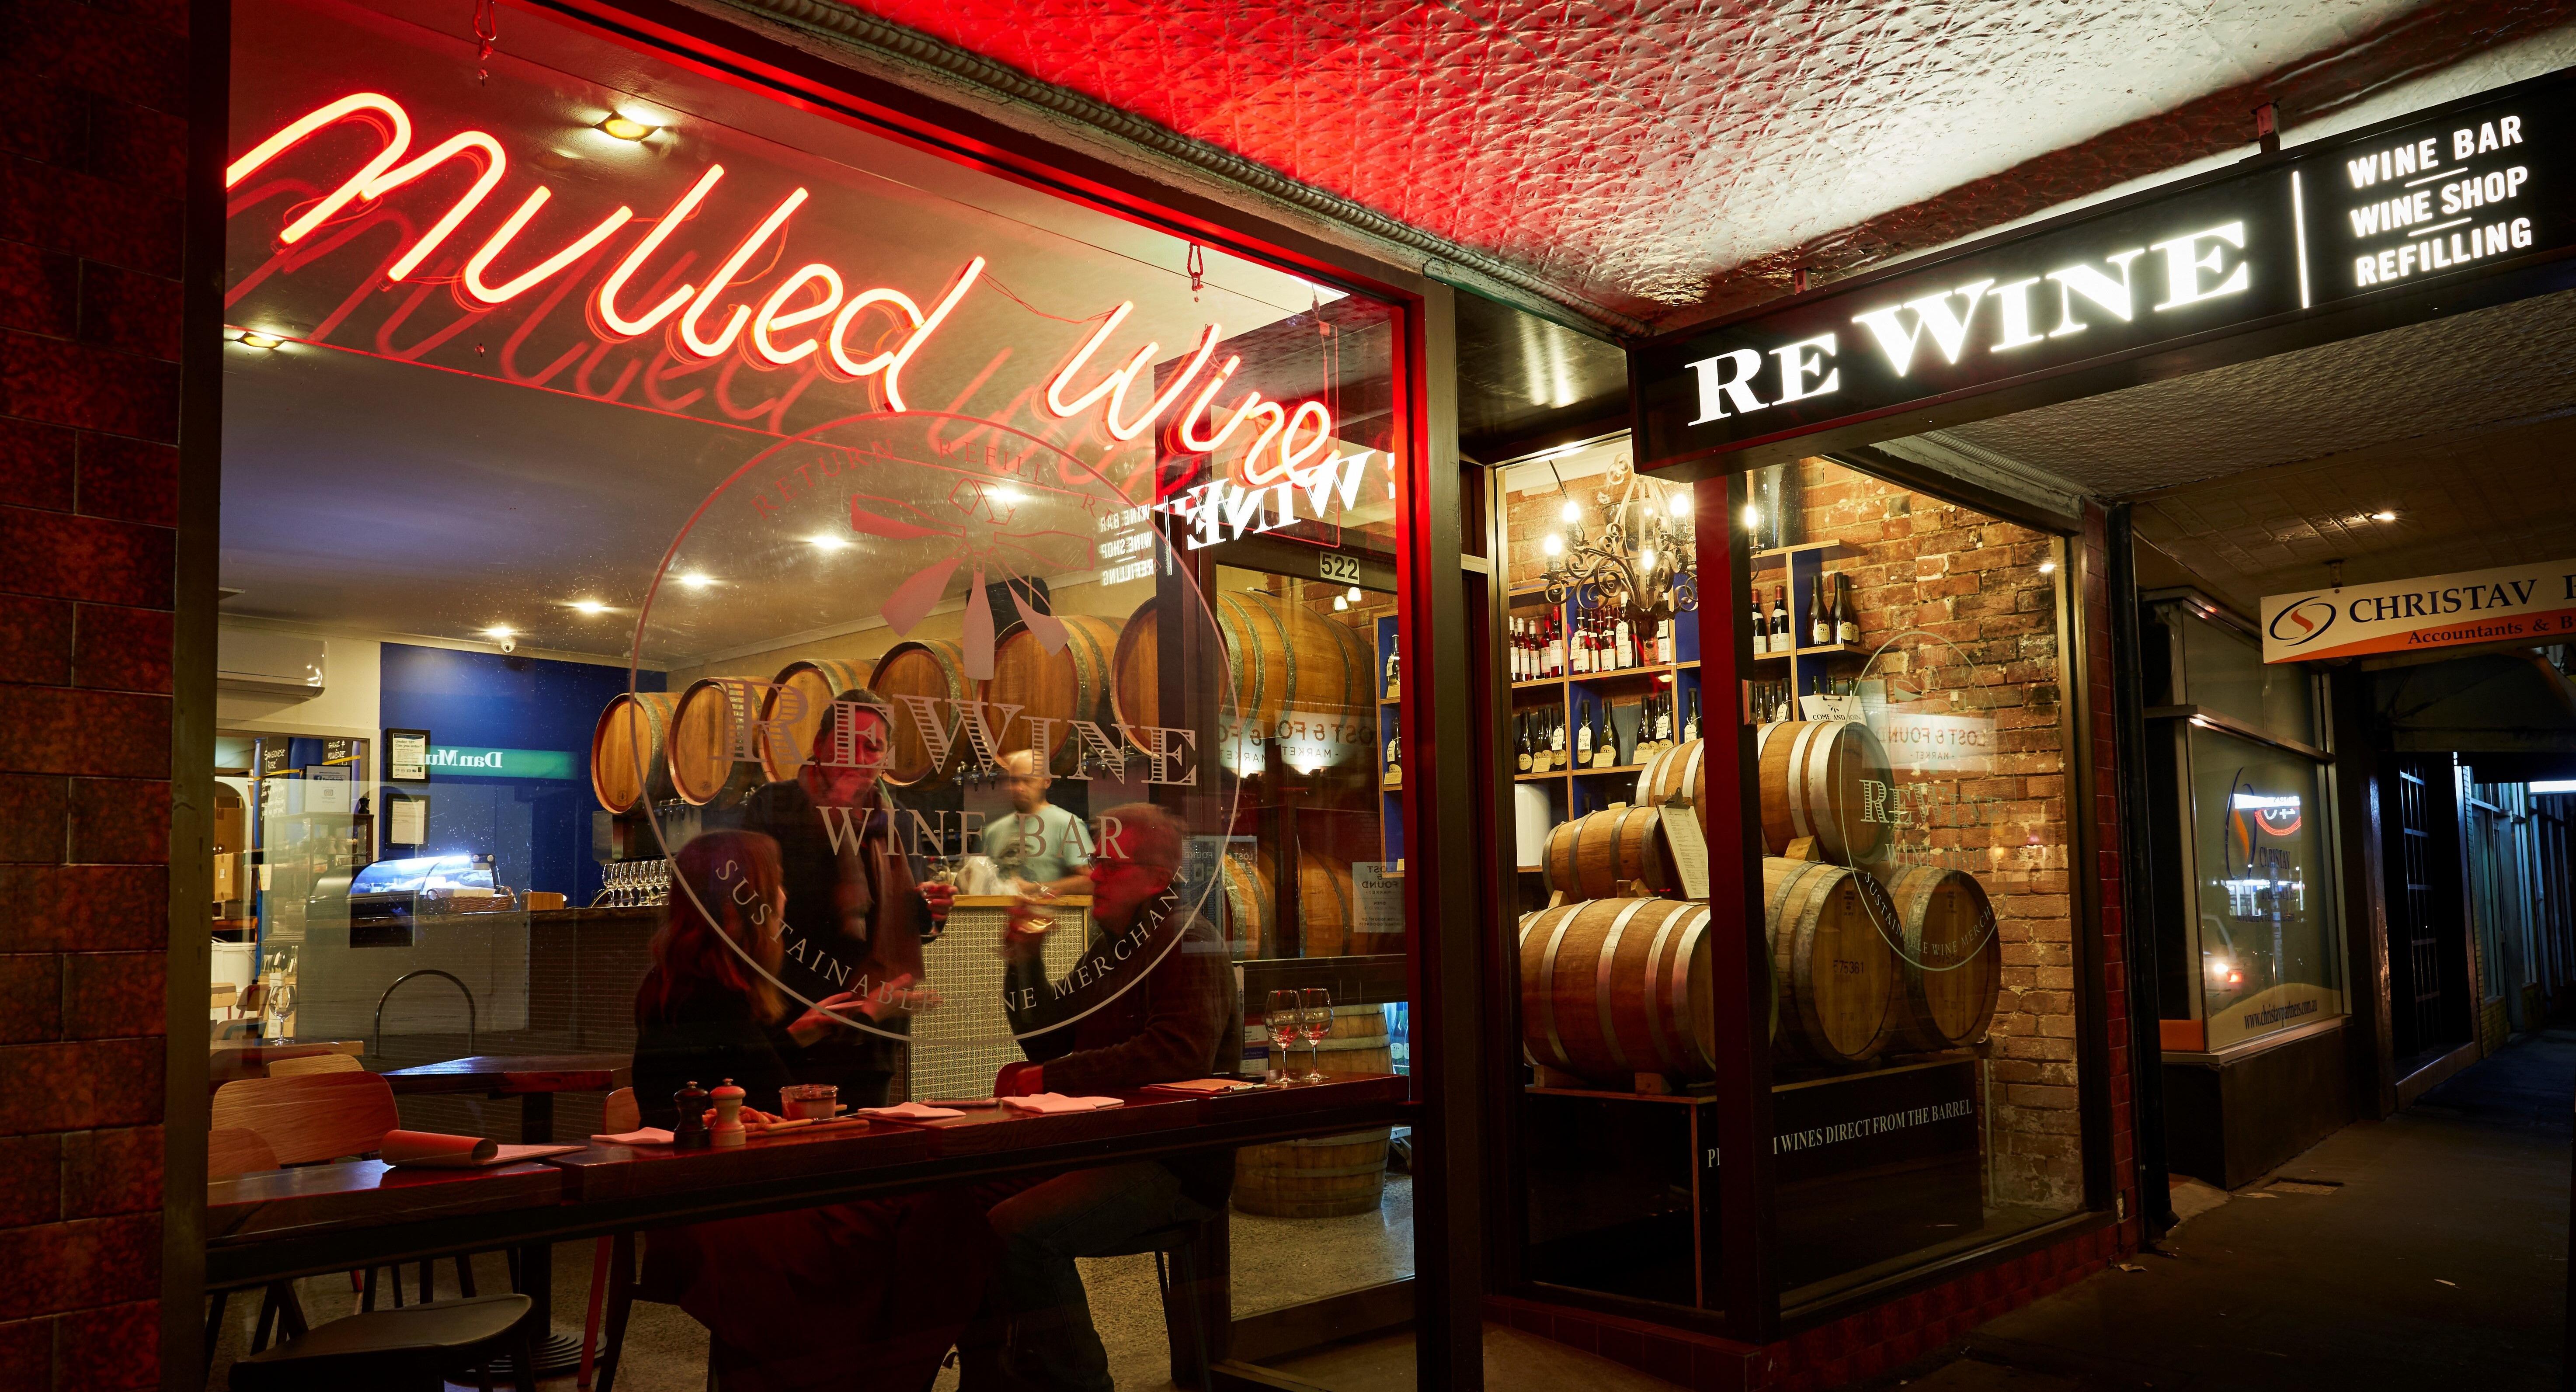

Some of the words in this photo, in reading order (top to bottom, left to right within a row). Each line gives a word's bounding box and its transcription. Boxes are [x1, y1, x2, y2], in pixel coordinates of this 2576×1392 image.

[2348, 137, 2438, 188] WINE
[2453, 115, 2523, 160] BAR
[2350, 190, 2433, 237] WINE
[2441, 166, 2528, 214] SHOP
[2356, 217, 2532, 287] REFILLING
[1046, 300, 1340, 489] Wine
[751, 439, 894, 519] RETURN
[937, 438, 1045, 485] REFILL
[1321, 557, 1359, 580] 522
[2349, 579, 2538, 623] CHRISTAV
[2408, 621, 2523, 645] Accountants
[2533, 618, 2550, 632] &
[2561, 615, 2576, 630] B
[816, 805, 987, 857] WINE
[1016, 812, 1130, 860] BAR
[1885, 844, 1933, 871] WINE
[1943, 846, 1987, 871] SHOP
[1053, 865, 1189, 1001] MERCHANT
[1932, 941, 1957, 956] WINE
[2244, 1000, 2317, 1030] www.christavpartners.com.au
[1781, 1128, 1823, 1152] WINES
[1826, 1118, 1870, 1145] DIRECT
[1873, 1111, 1905, 1135] FROM
[1908, 1107, 1929, 1127] THE
[1932, 1099, 1972, 1122] BARREL
